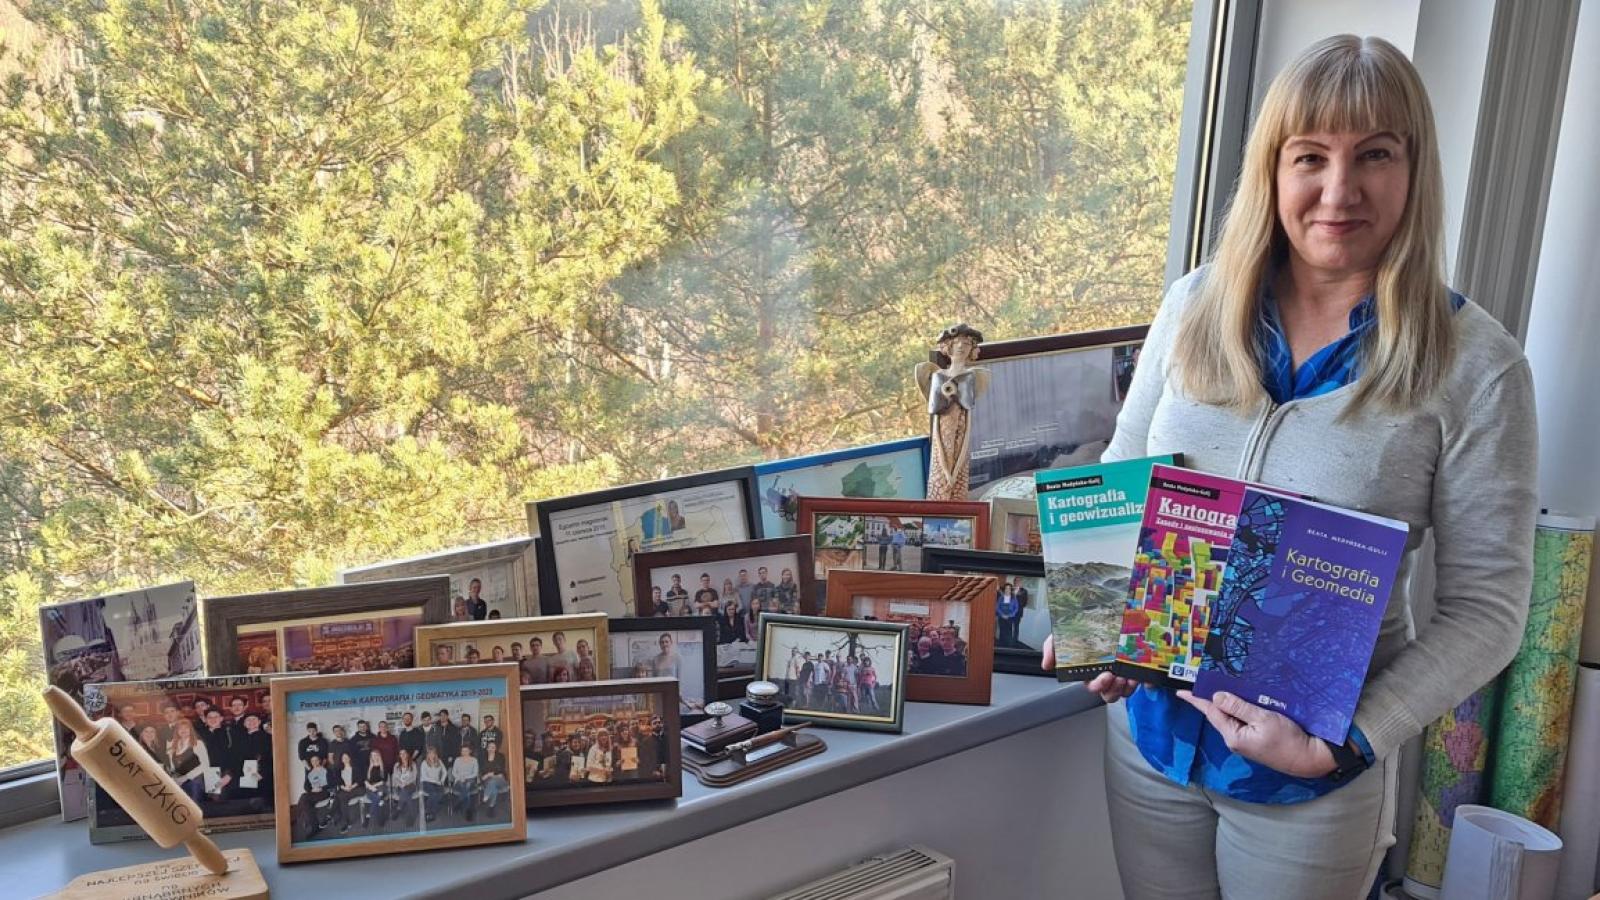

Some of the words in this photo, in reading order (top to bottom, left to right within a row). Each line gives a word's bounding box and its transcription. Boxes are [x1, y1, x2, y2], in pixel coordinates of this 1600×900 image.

[1048, 489, 1126, 509] Kartografia
[1050, 513, 1055, 525] i
[1159, 497, 1238, 527] Kartogra
[1307, 528, 1329, 539] BEATA
[1286, 547, 1380, 588] Kartografia
[1281, 565, 1288, 578] i
[1291, 569, 1375, 604] Geomedia
[136, 677, 229, 692] ABSOLWENCI
[232, 676, 261, 687] 2014
[300, 701, 331, 710] Pierwszy
[359, 694, 410, 704] KARTOGRAFIA
[416, 691, 459, 700] GEOMATYKA
[142, 773, 191, 824] ZKIG
